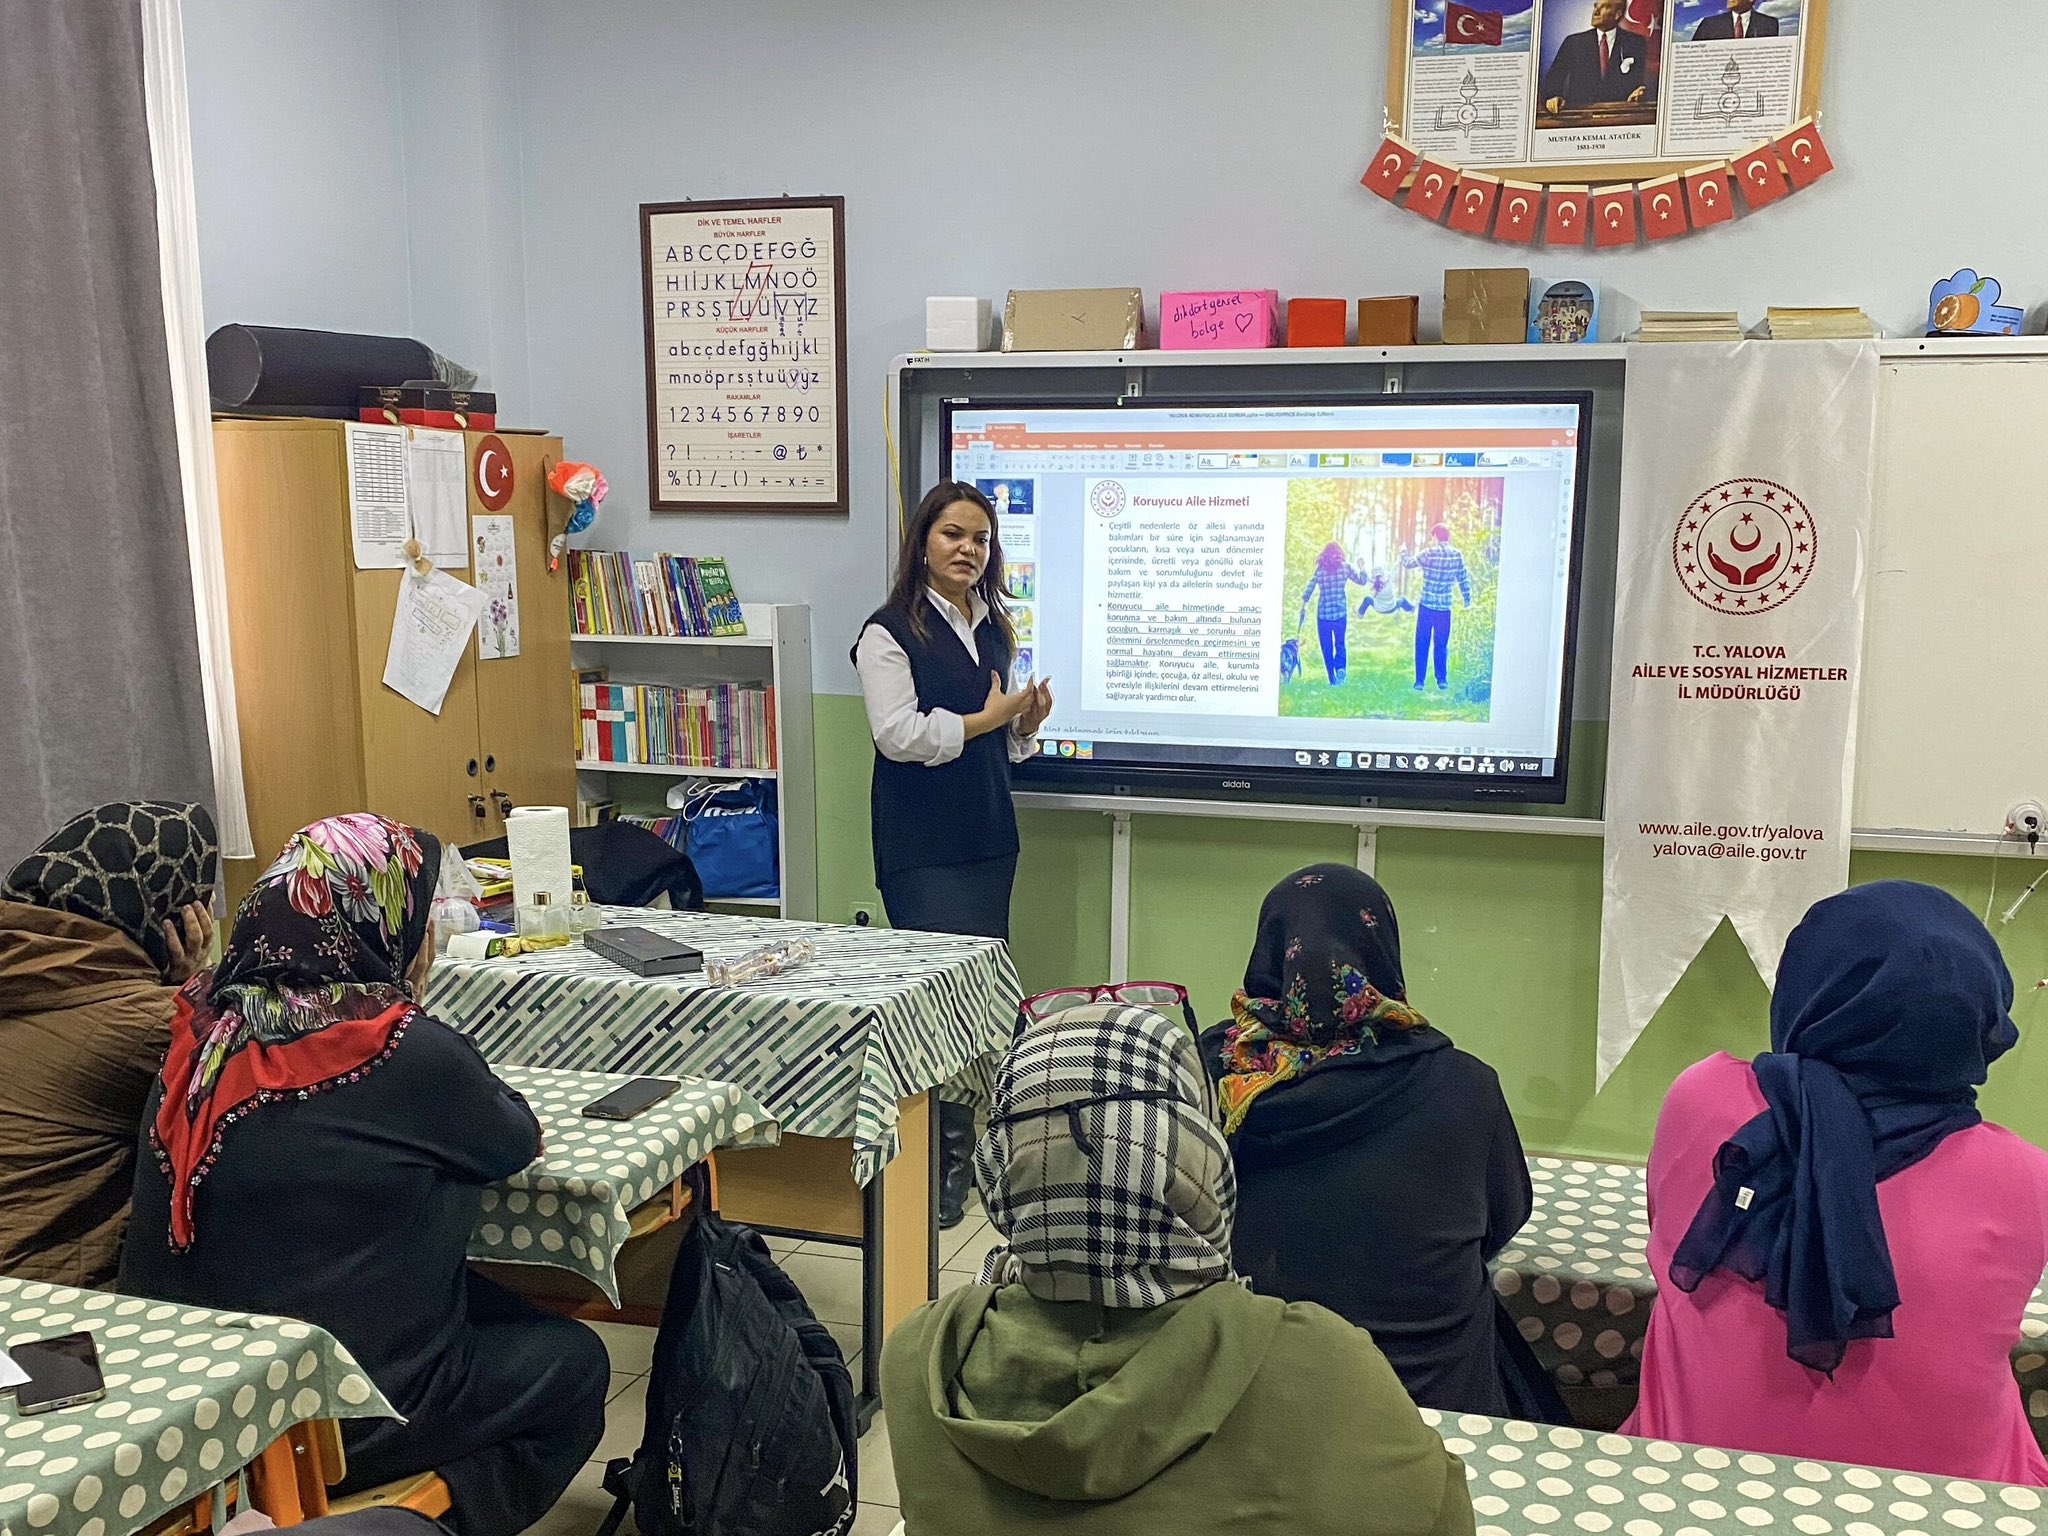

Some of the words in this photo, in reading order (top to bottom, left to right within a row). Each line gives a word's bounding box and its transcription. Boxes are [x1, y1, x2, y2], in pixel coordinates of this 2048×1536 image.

[1609, 132, 1641, 140] ATATÜRK
[723, 218, 746, 226] TEMEL
[748, 216, 782, 225] HARFLER
[716, 325, 738, 335] KÜÇÜK
[739, 325, 768, 334] HARFLER
[1133, 496, 1182, 508] Koruyucu
[1185, 496, 1206, 506] Aile
[1209, 496, 1250, 506] Hizmeti
[1109, 522, 1132, 531] Çeşitli
[1140, 522, 1180, 530] nedenlerle
[1234, 523, 1264, 532] yanında
[1109, 533, 1143, 541] bakımları
[1190, 534, 1203, 543] için
[1210, 534, 1264, 543] sağlanamayan
[1176, 547, 1194, 555] veya
[1226, 546, 1264, 554] dönemler
[1152, 557, 1176, 565] ücretli
[1181, 558, 1199, 566] veya
[1205, 558, 1233, 567] gönüllü
[1108, 568, 1131, 576] bakım
[1156, 568, 1213, 578] sorumluluğunu
[1221, 569, 1245, 577] devlet
[1253, 570, 1263, 578] ile
[1108, 579, 1140, 588] paylaşan
[1143, 580, 1155, 589] kişi
[1170, 580, 1180, 588] da
[1216, 581, 1249, 590] sunduğu
[1252, 581, 1262, 589] bir
[1107, 602, 1142, 611] Koruyucu
[1155, 603, 1169, 611] aile
[1182, 603, 1225, 611] hizmetinde
[1195, 615, 1222, 623] altında
[1230, 616, 1261, 624] bulunan
[1148, 626, 1182, 634] karmaşık
[1207, 627, 1236, 635] sorunlu
[1204, 639, 1247, 647] geçirmesini
[1143, 649, 1173, 657] hayatını
[1183, 649, 1208, 657] devam
[1693, 645, 1720, 658] T.C.
[1724, 646, 1787, 659] YALOVA
[1159, 660, 1195, 669] Koruyucu
[1228, 662, 1260, 670] kurumla
[1106, 670, 1132, 679] işbirliği
[1226, 673, 1247, 681] okulu
[1632, 663, 1666, 678] AİLE
[1669, 666, 1689, 678] VE
[1693, 666, 1753, 679] SOSYAL
[1757, 664, 1848, 681] HİZMETLER
[1106, 681, 1142, 690] çevresiyle
[1145, 682, 1180, 691] ilişkilerini
[1183, 683, 1208, 691] devam
[1211, 684, 1259, 692] ettirmelerini
[1678, 683, 1692, 699] İL
[1696, 684, 1801, 701] MÜDÜRLÜĞÜ
[1106, 693, 1144, 701] sağlayarak
[1145, 694, 1178, 702] yardımcı
[1519, 762, 1539, 771] 11:27
[1222, 780, 1251, 789] aidata
[1639, 822, 1824, 842] www.aile.gov.tr/yalova
[1653, 842, 1807, 862] yalova@aile.gov.tr
